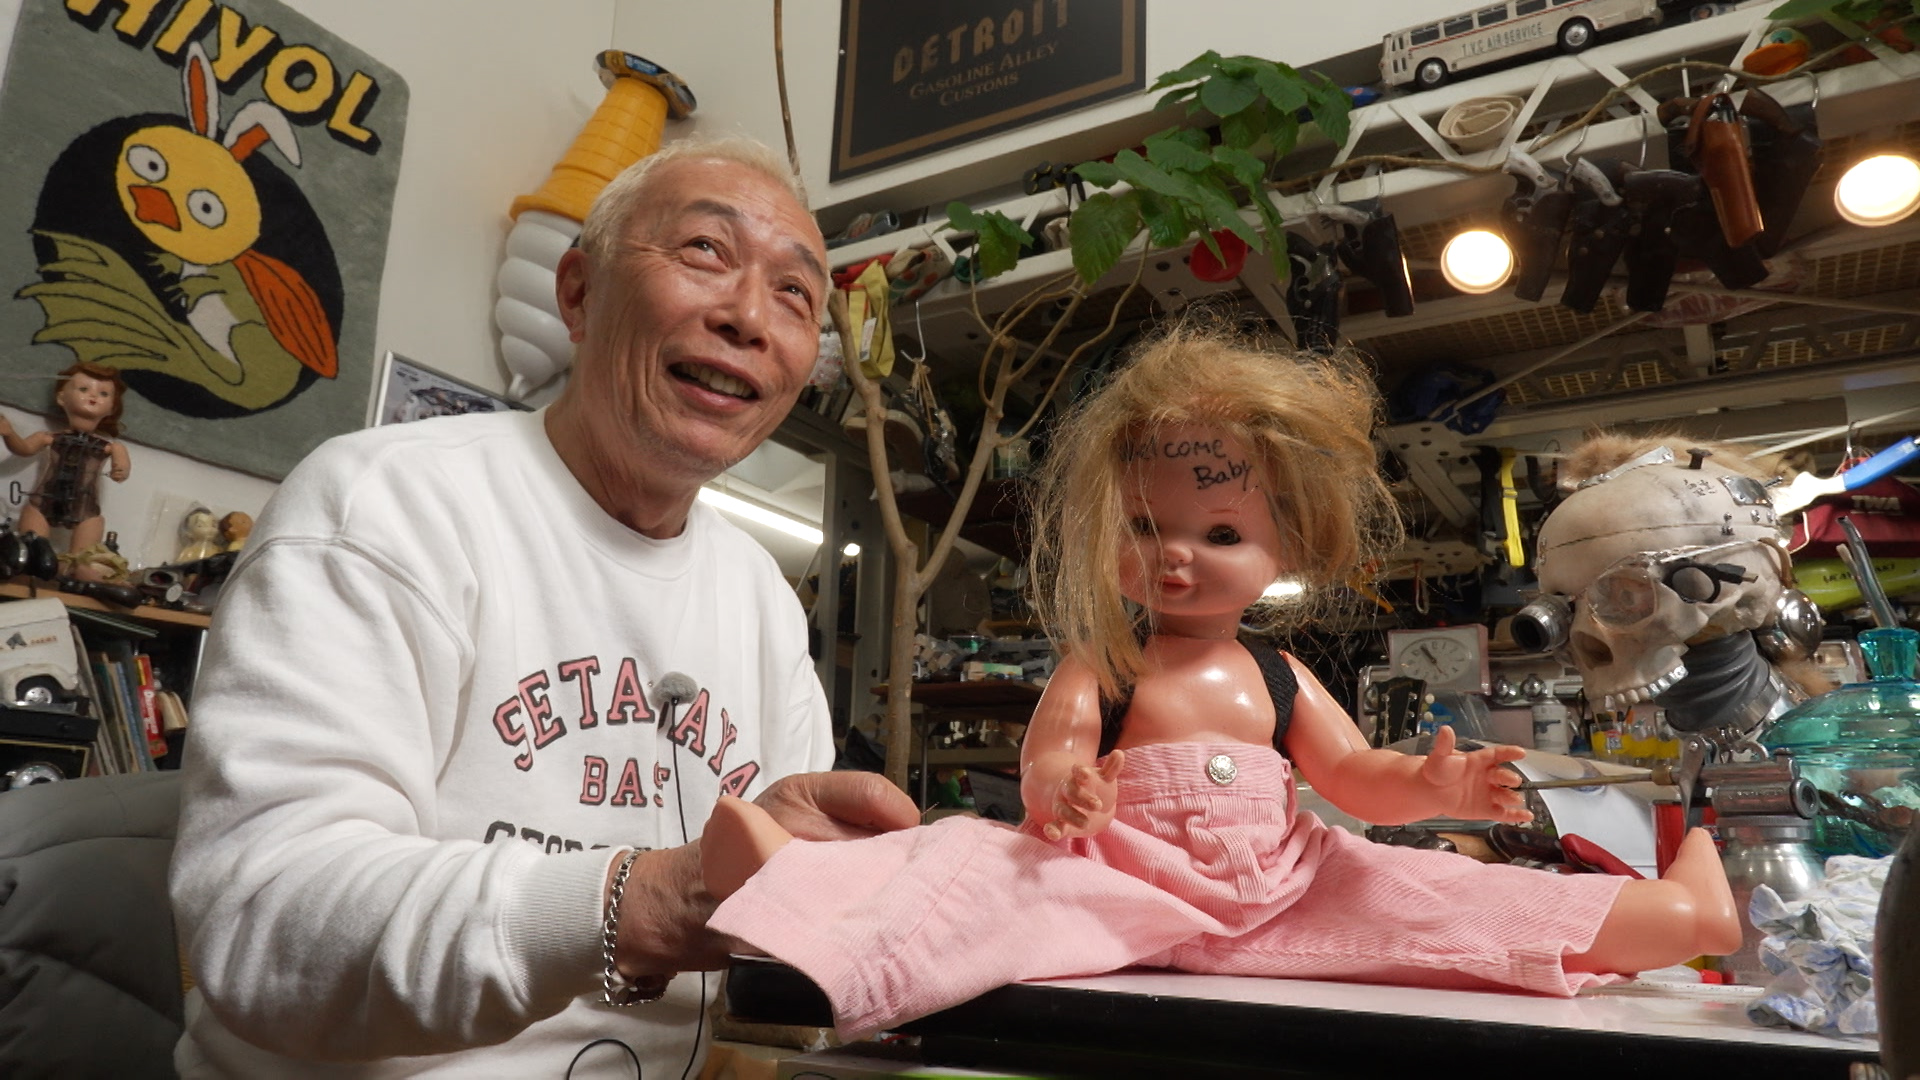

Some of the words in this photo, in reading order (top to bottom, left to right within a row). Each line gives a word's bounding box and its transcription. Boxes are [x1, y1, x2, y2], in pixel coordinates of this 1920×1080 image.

[1503, 22, 1544, 48] SERVICE
[1193, 459, 1252, 492] Baby
[1850, 494, 1901, 511] TWA
[493, 655, 760, 798] SETAAYA
